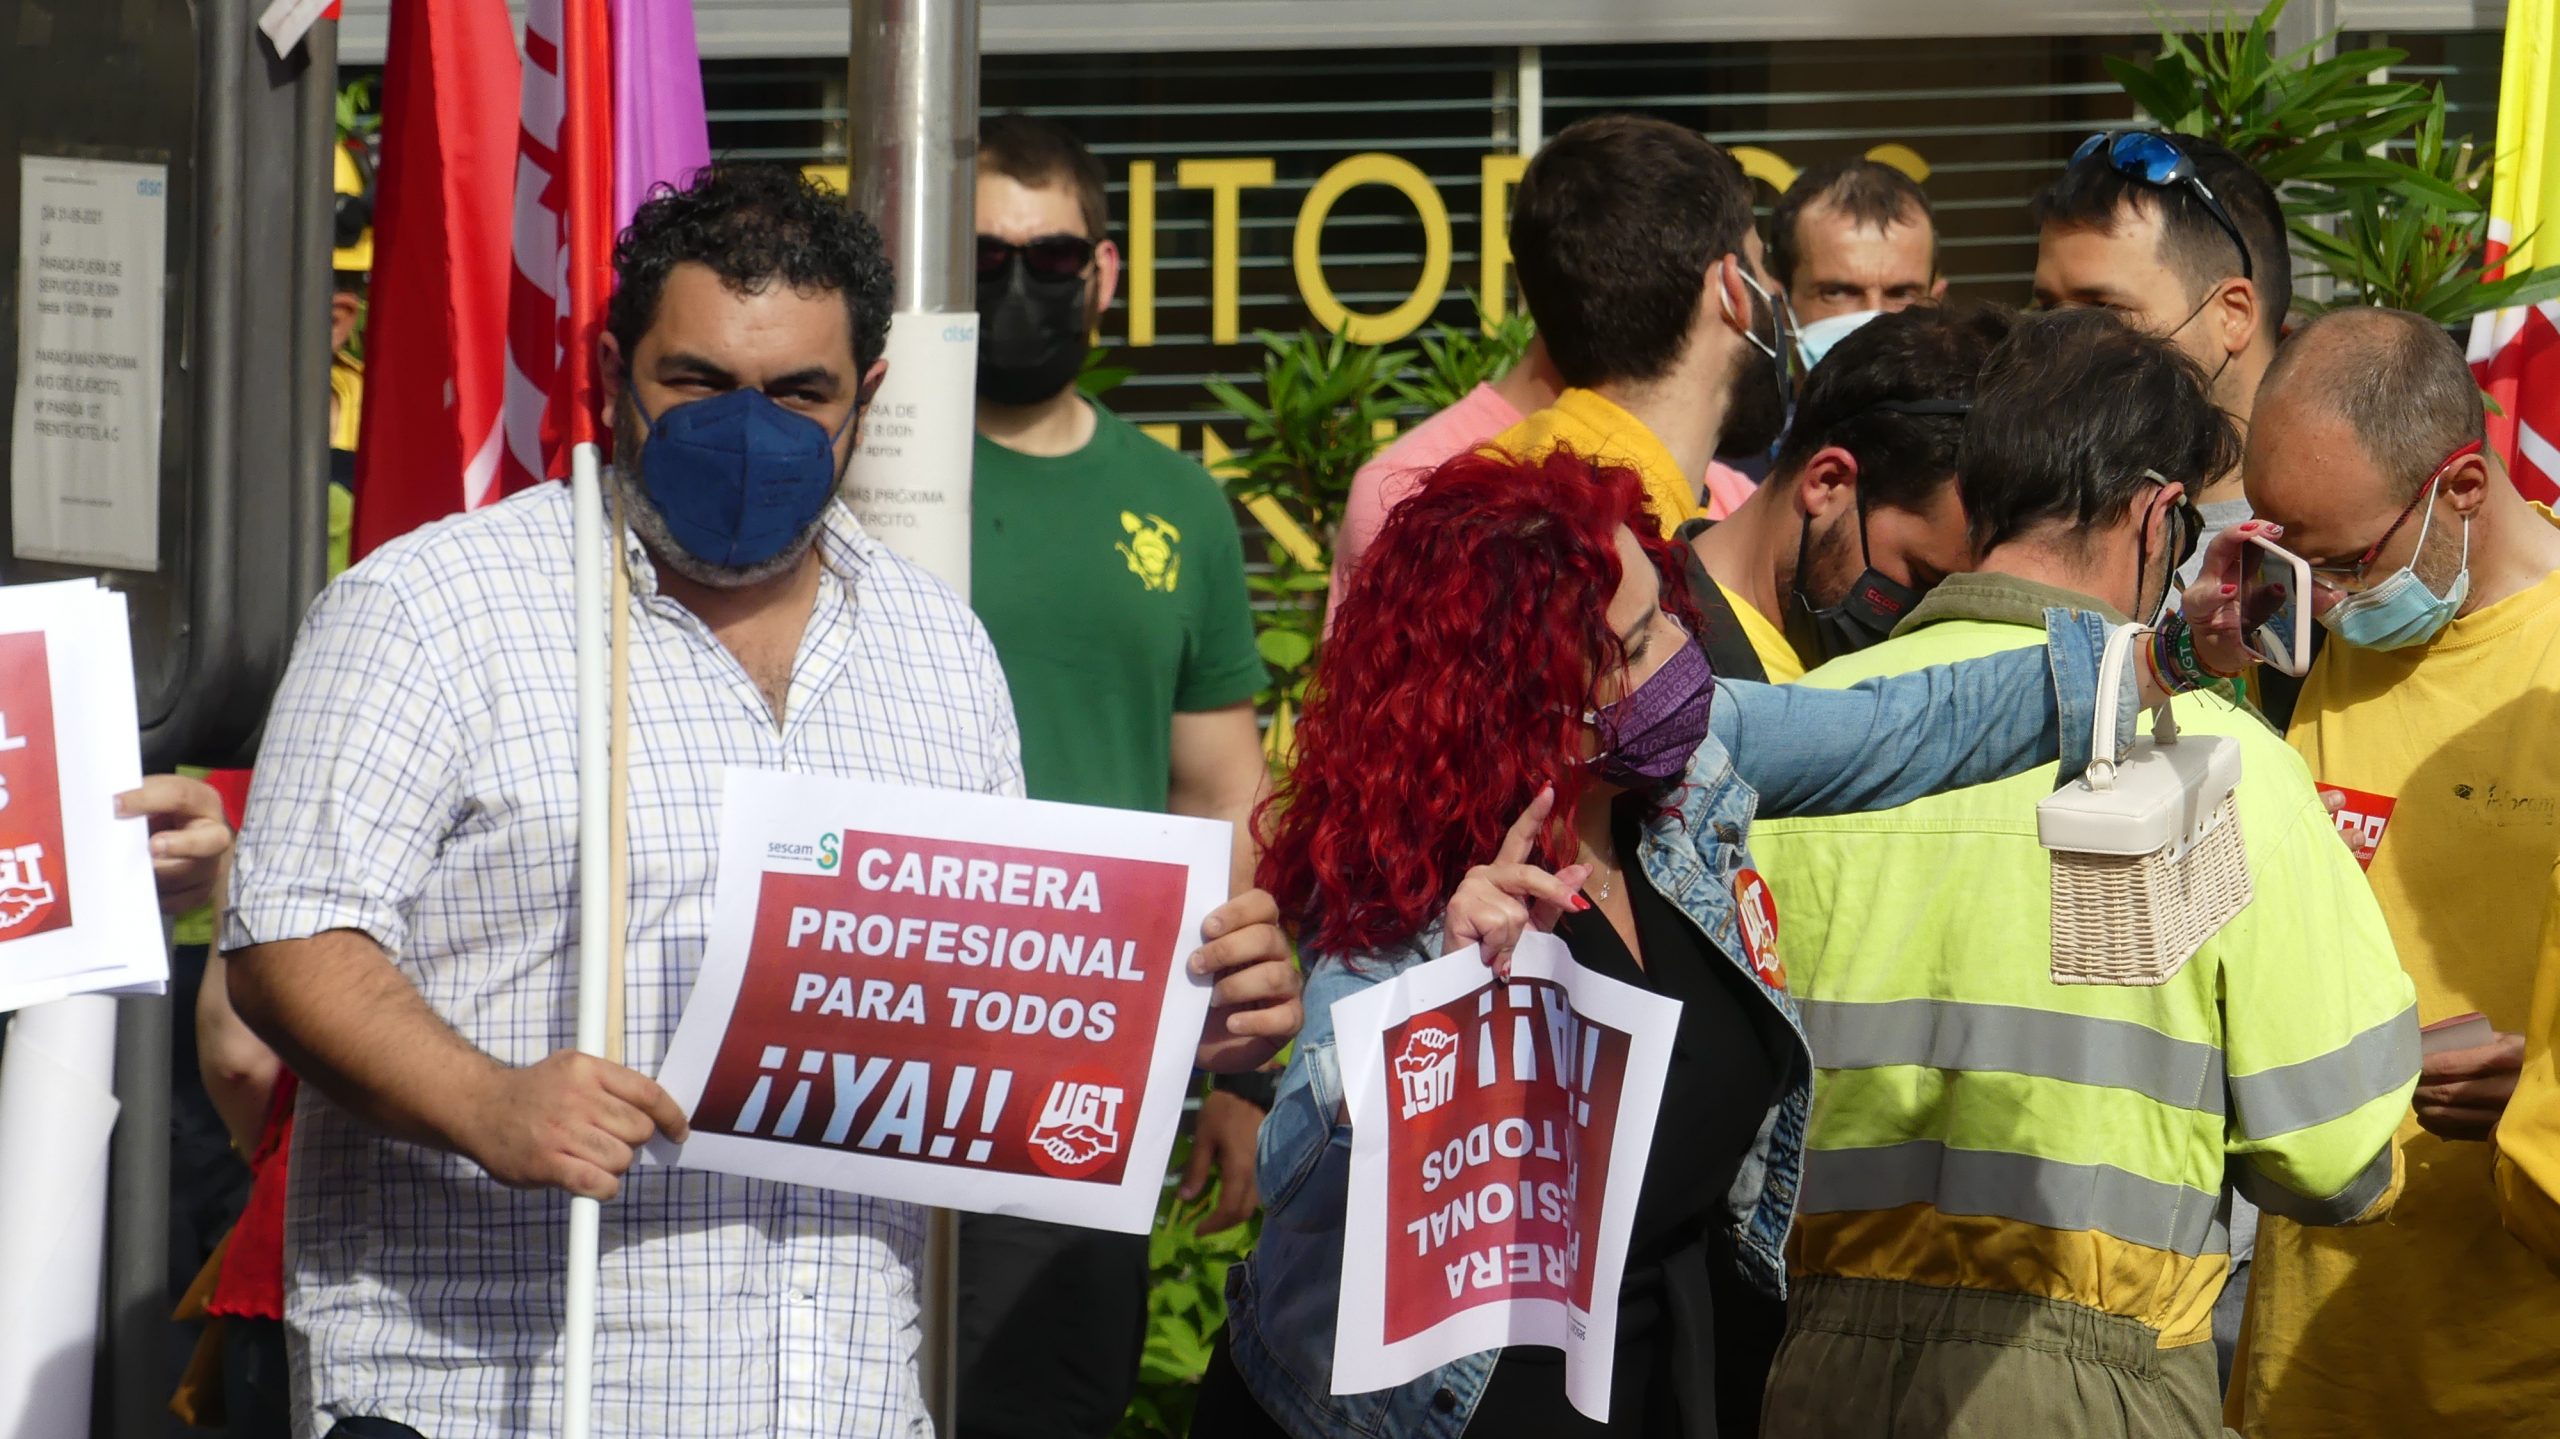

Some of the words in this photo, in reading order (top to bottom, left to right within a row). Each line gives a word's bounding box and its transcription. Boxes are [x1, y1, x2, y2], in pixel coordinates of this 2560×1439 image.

[894, 404, 917, 420] DE
[1641, 696, 1667, 719] POR
[1665, 675, 1690, 698] LOS
[768, 842, 813, 856] sescam
[856, 847, 1103, 914] CARRERA
[786, 906, 1146, 982] PROFESIONAL
[789, 973, 927, 1026] PARA
[946, 987, 1118, 1043] TODOS
[732, 1044, 1015, 1164] ¡¡YA!!
[1041, 1080, 1125, 1133] UGT
[1401, 1053, 1458, 1120] UGT
[1422, 1117, 1561, 1194] TODOS
[1444, 1242, 1567, 1300] RERA
